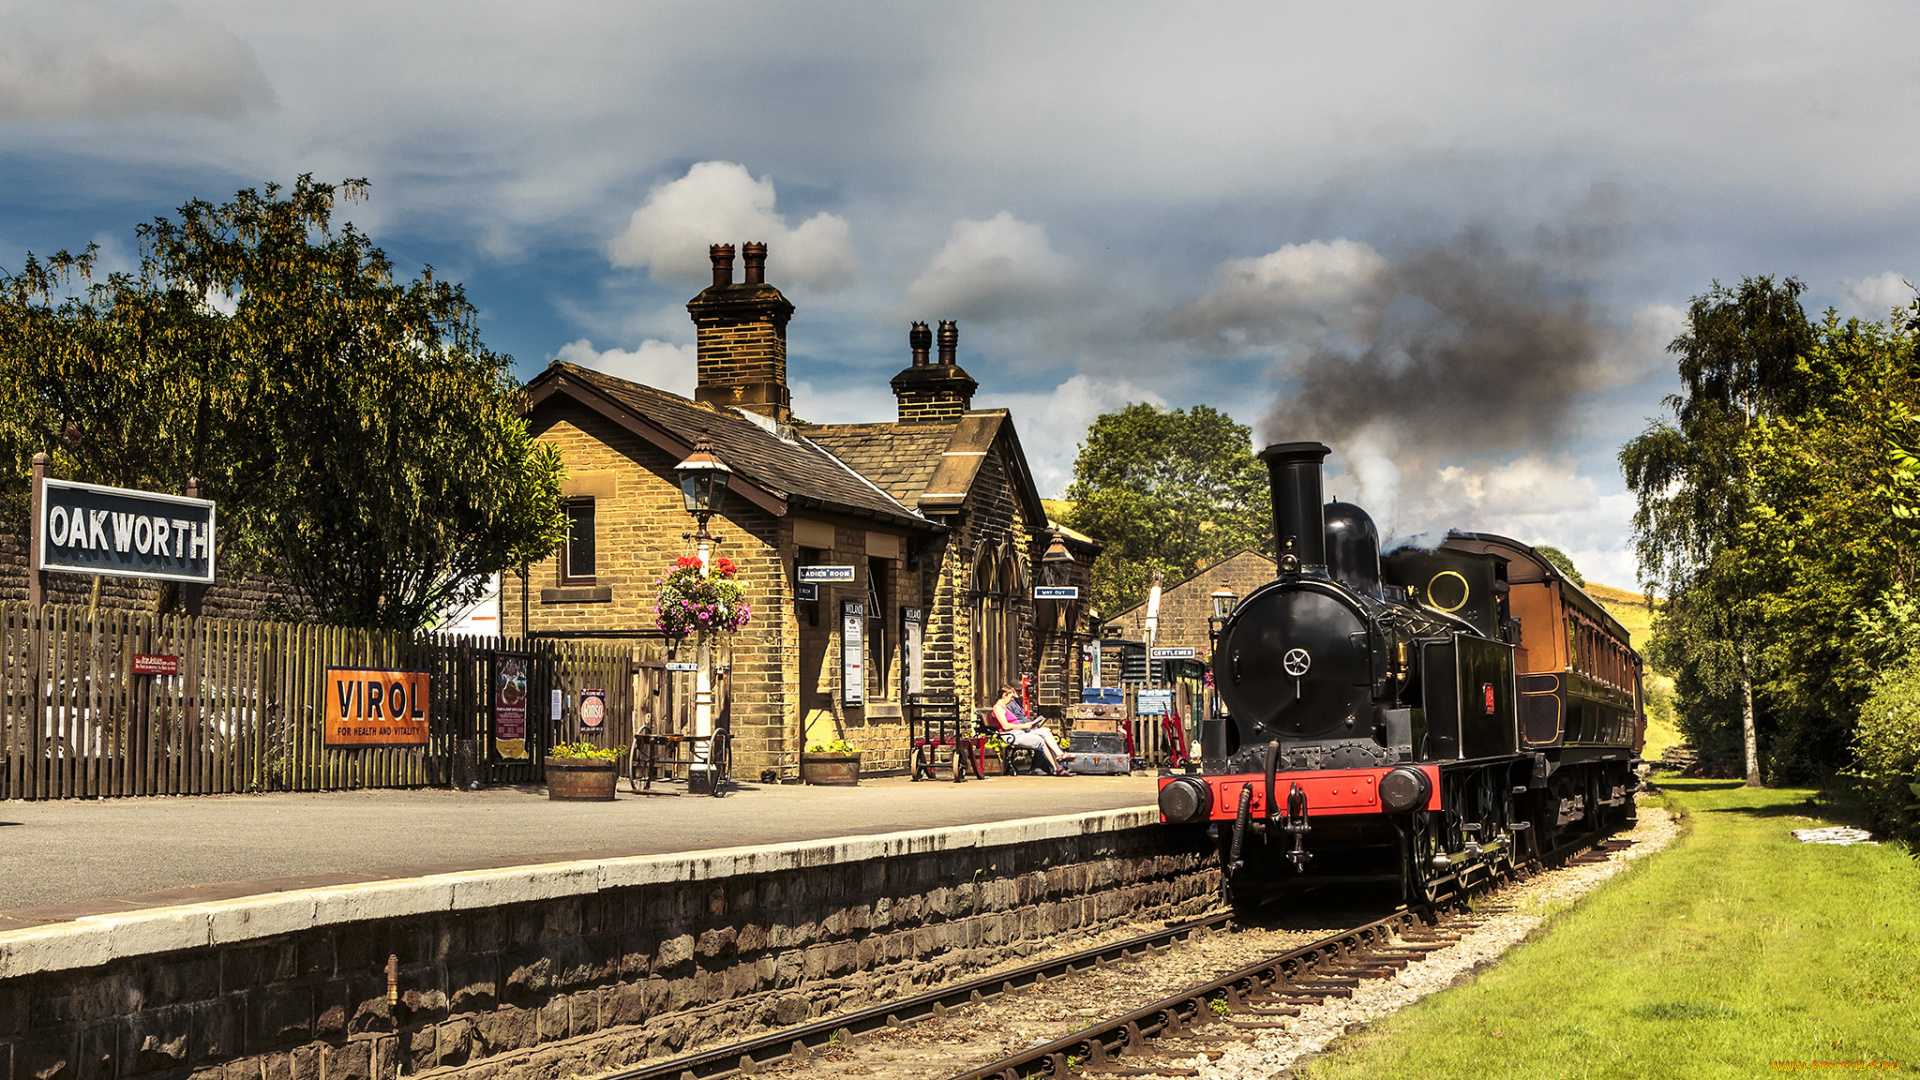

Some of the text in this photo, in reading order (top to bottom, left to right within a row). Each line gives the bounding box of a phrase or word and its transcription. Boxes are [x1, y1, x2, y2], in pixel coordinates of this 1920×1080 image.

[49, 505, 208, 559] OAKWORTH
[337, 680, 425, 721] VIROL
[583, 700, 603, 719] Rinso
[337, 726, 420, 736] FOR HEALTH AND VITALITY
